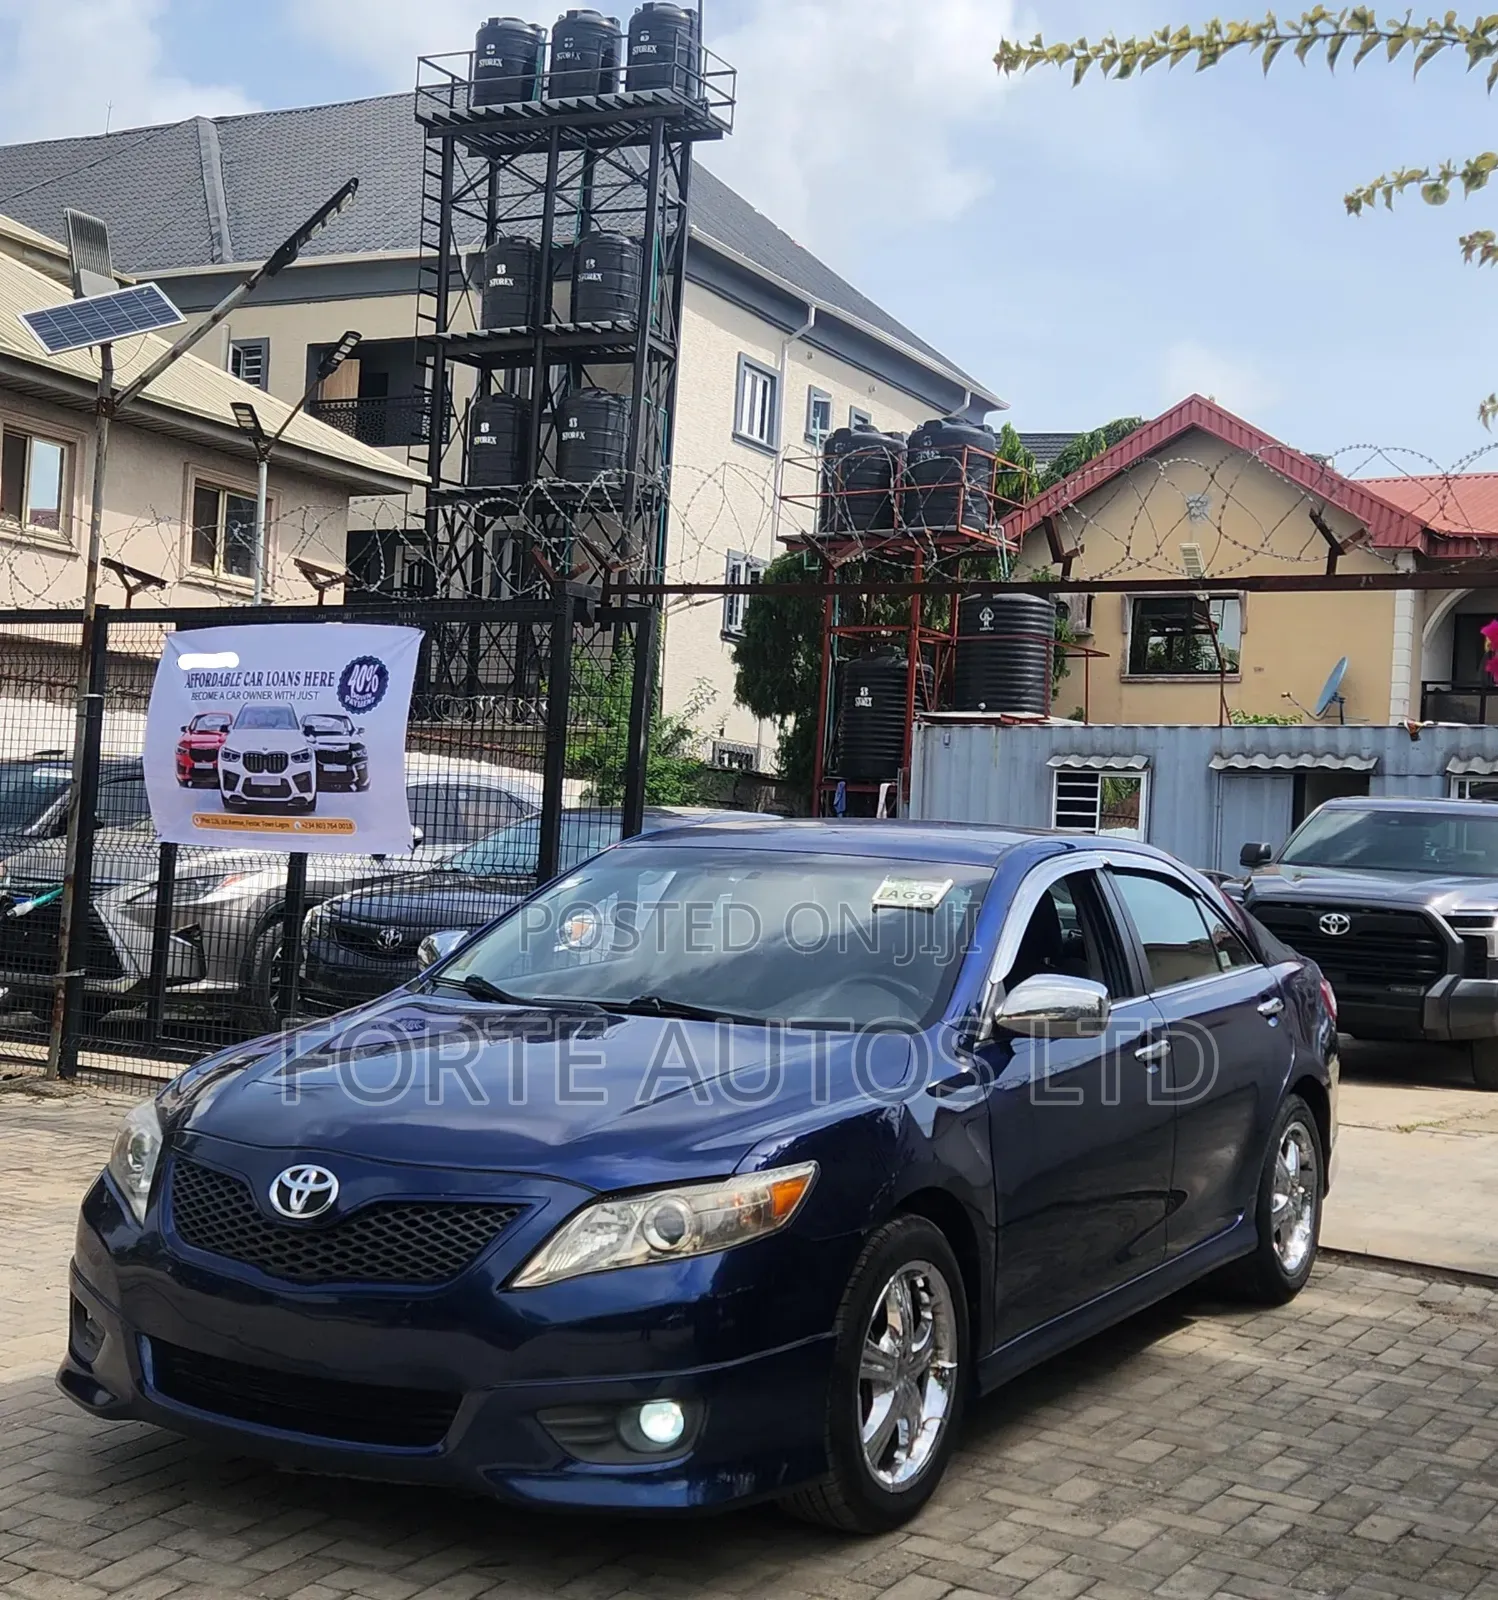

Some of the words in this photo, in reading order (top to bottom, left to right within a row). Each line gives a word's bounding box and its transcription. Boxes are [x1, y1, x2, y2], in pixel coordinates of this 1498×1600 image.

[631, 44, 658, 55] STOREX
[478, 58, 503, 68] STOREX
[489, 277, 514, 287] STOREX
[473, 435, 497, 445] STOREX
[562, 430, 586, 441] STOREX
[184, 671, 243, 688] AFFORDABLE
[243, 671, 264, 687] CAR
[266, 671, 302, 687] LOANS
[303, 671, 335, 687] HERE
[347, 664, 379, 692] 40%
[191, 691, 219, 701] BECOME
[219, 691, 225, 700] A
[226, 691, 241, 700] CAR
[242, 690, 273, 700] OWNER
[273, 691, 296, 700] WITH
[296, 690, 320, 701] JUST
